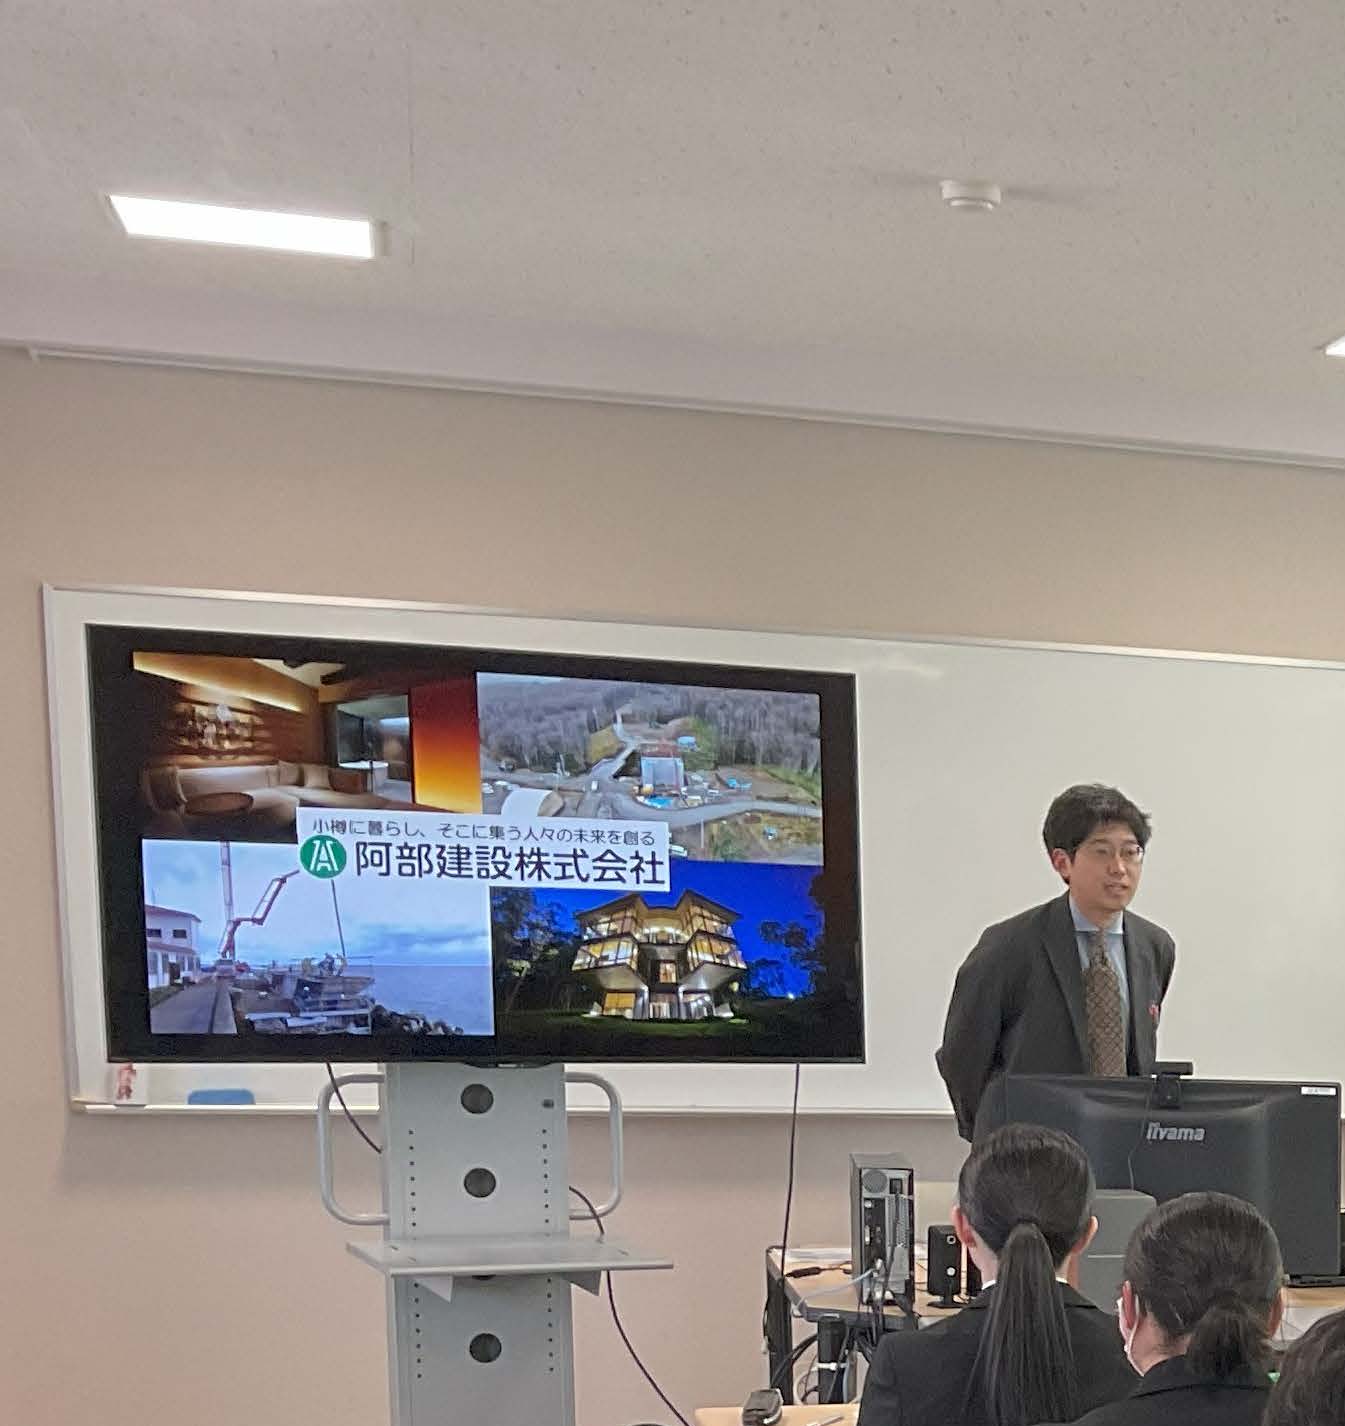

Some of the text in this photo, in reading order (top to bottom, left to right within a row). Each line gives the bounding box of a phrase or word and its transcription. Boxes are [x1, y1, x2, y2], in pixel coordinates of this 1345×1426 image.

[354, 840, 666, 885] 阿部建設株式会社
